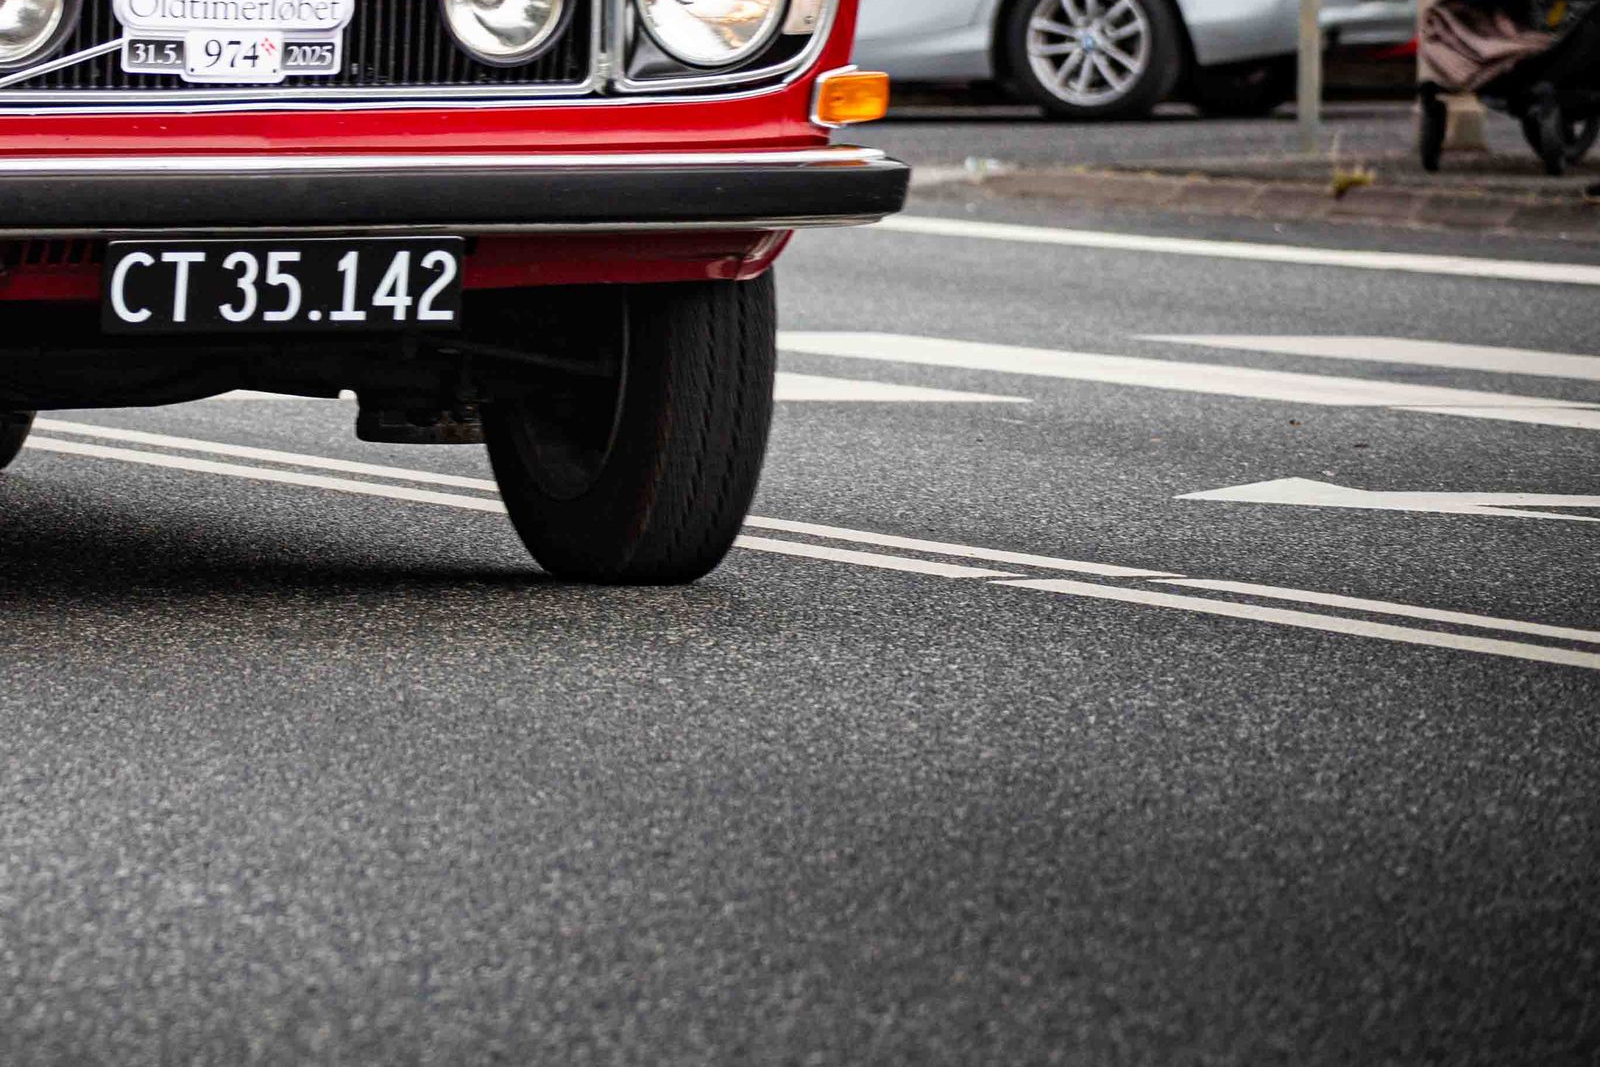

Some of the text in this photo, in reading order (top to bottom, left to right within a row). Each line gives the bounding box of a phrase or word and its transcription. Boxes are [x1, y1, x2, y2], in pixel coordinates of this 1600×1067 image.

[132, 43, 182, 65] 31.5.
[204, 39, 260, 69] 974
[286, 45, 333, 66] 2025
[110, 250, 458, 323] CT 35.142
